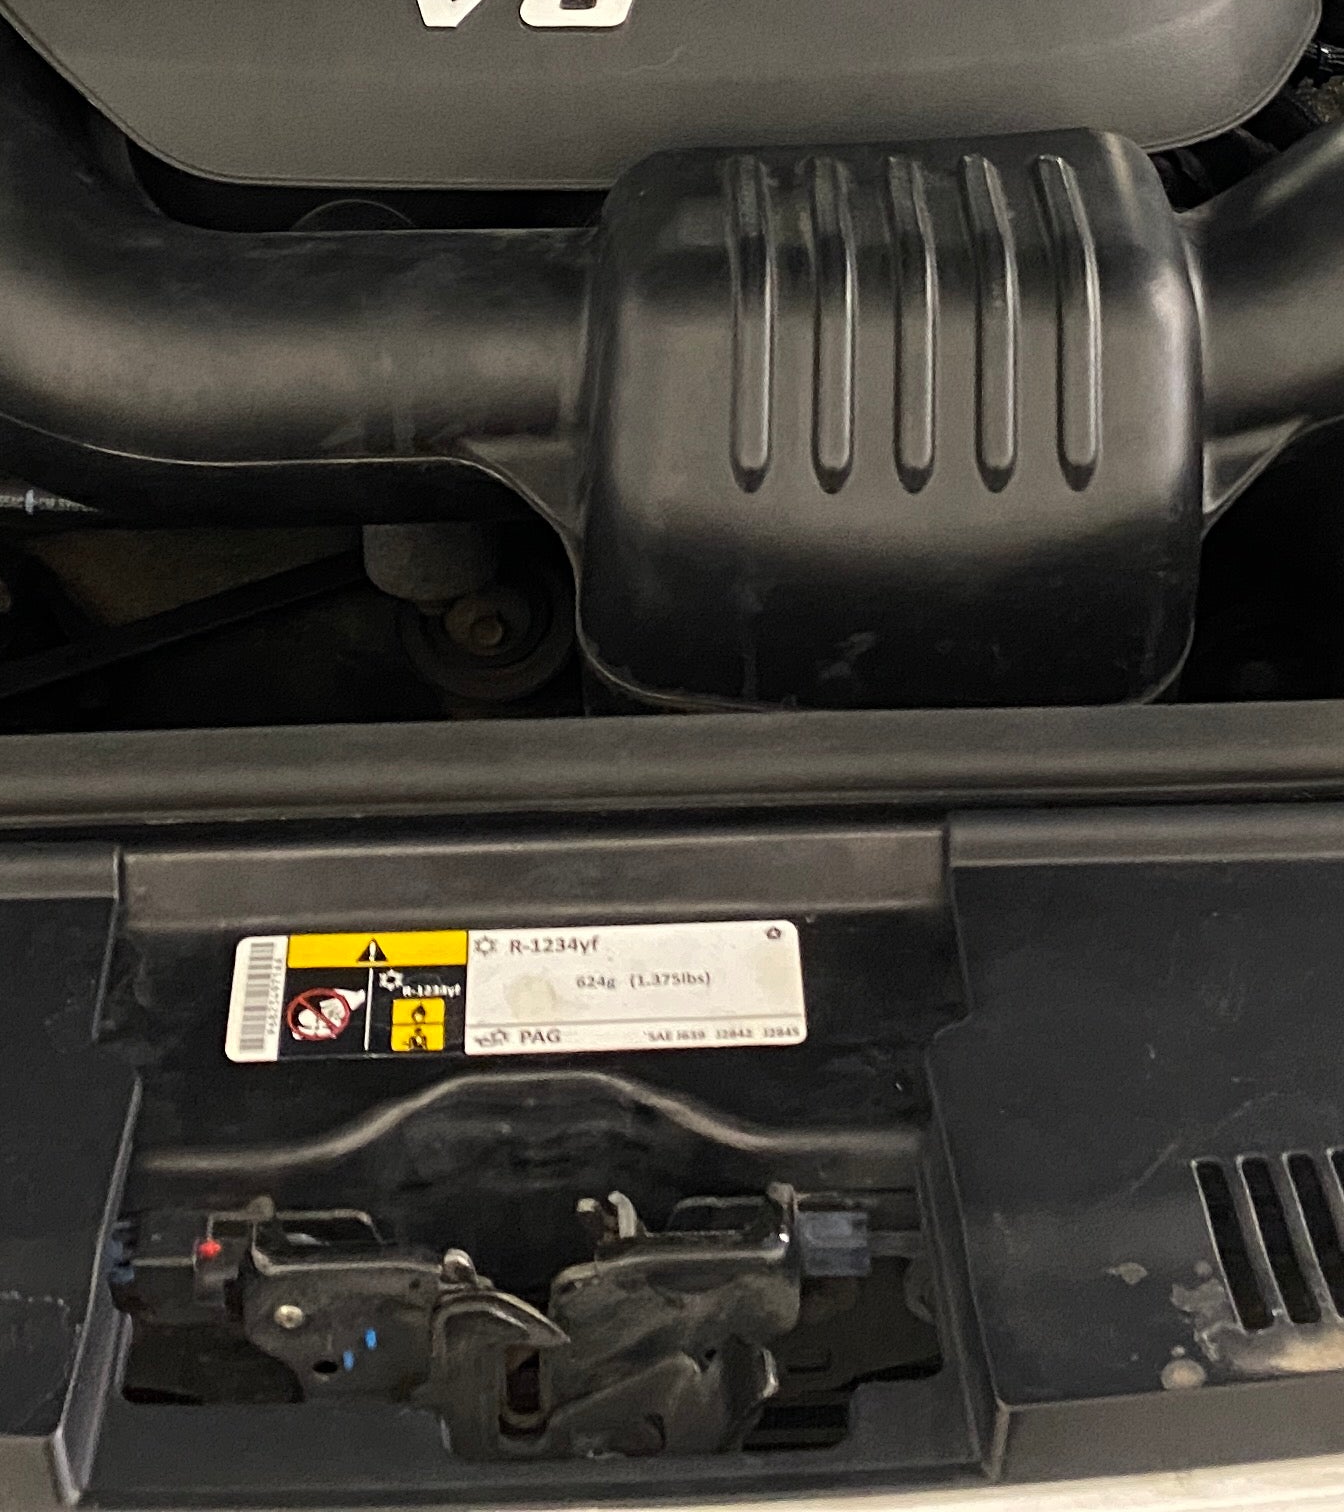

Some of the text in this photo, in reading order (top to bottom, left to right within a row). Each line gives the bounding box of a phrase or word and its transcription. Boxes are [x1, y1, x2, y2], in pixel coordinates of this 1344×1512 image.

[510, 935, 600, 955] R-1234yf
[576, 974, 616, 990] 624g
[520, 1028, 562, 1044] PAG
